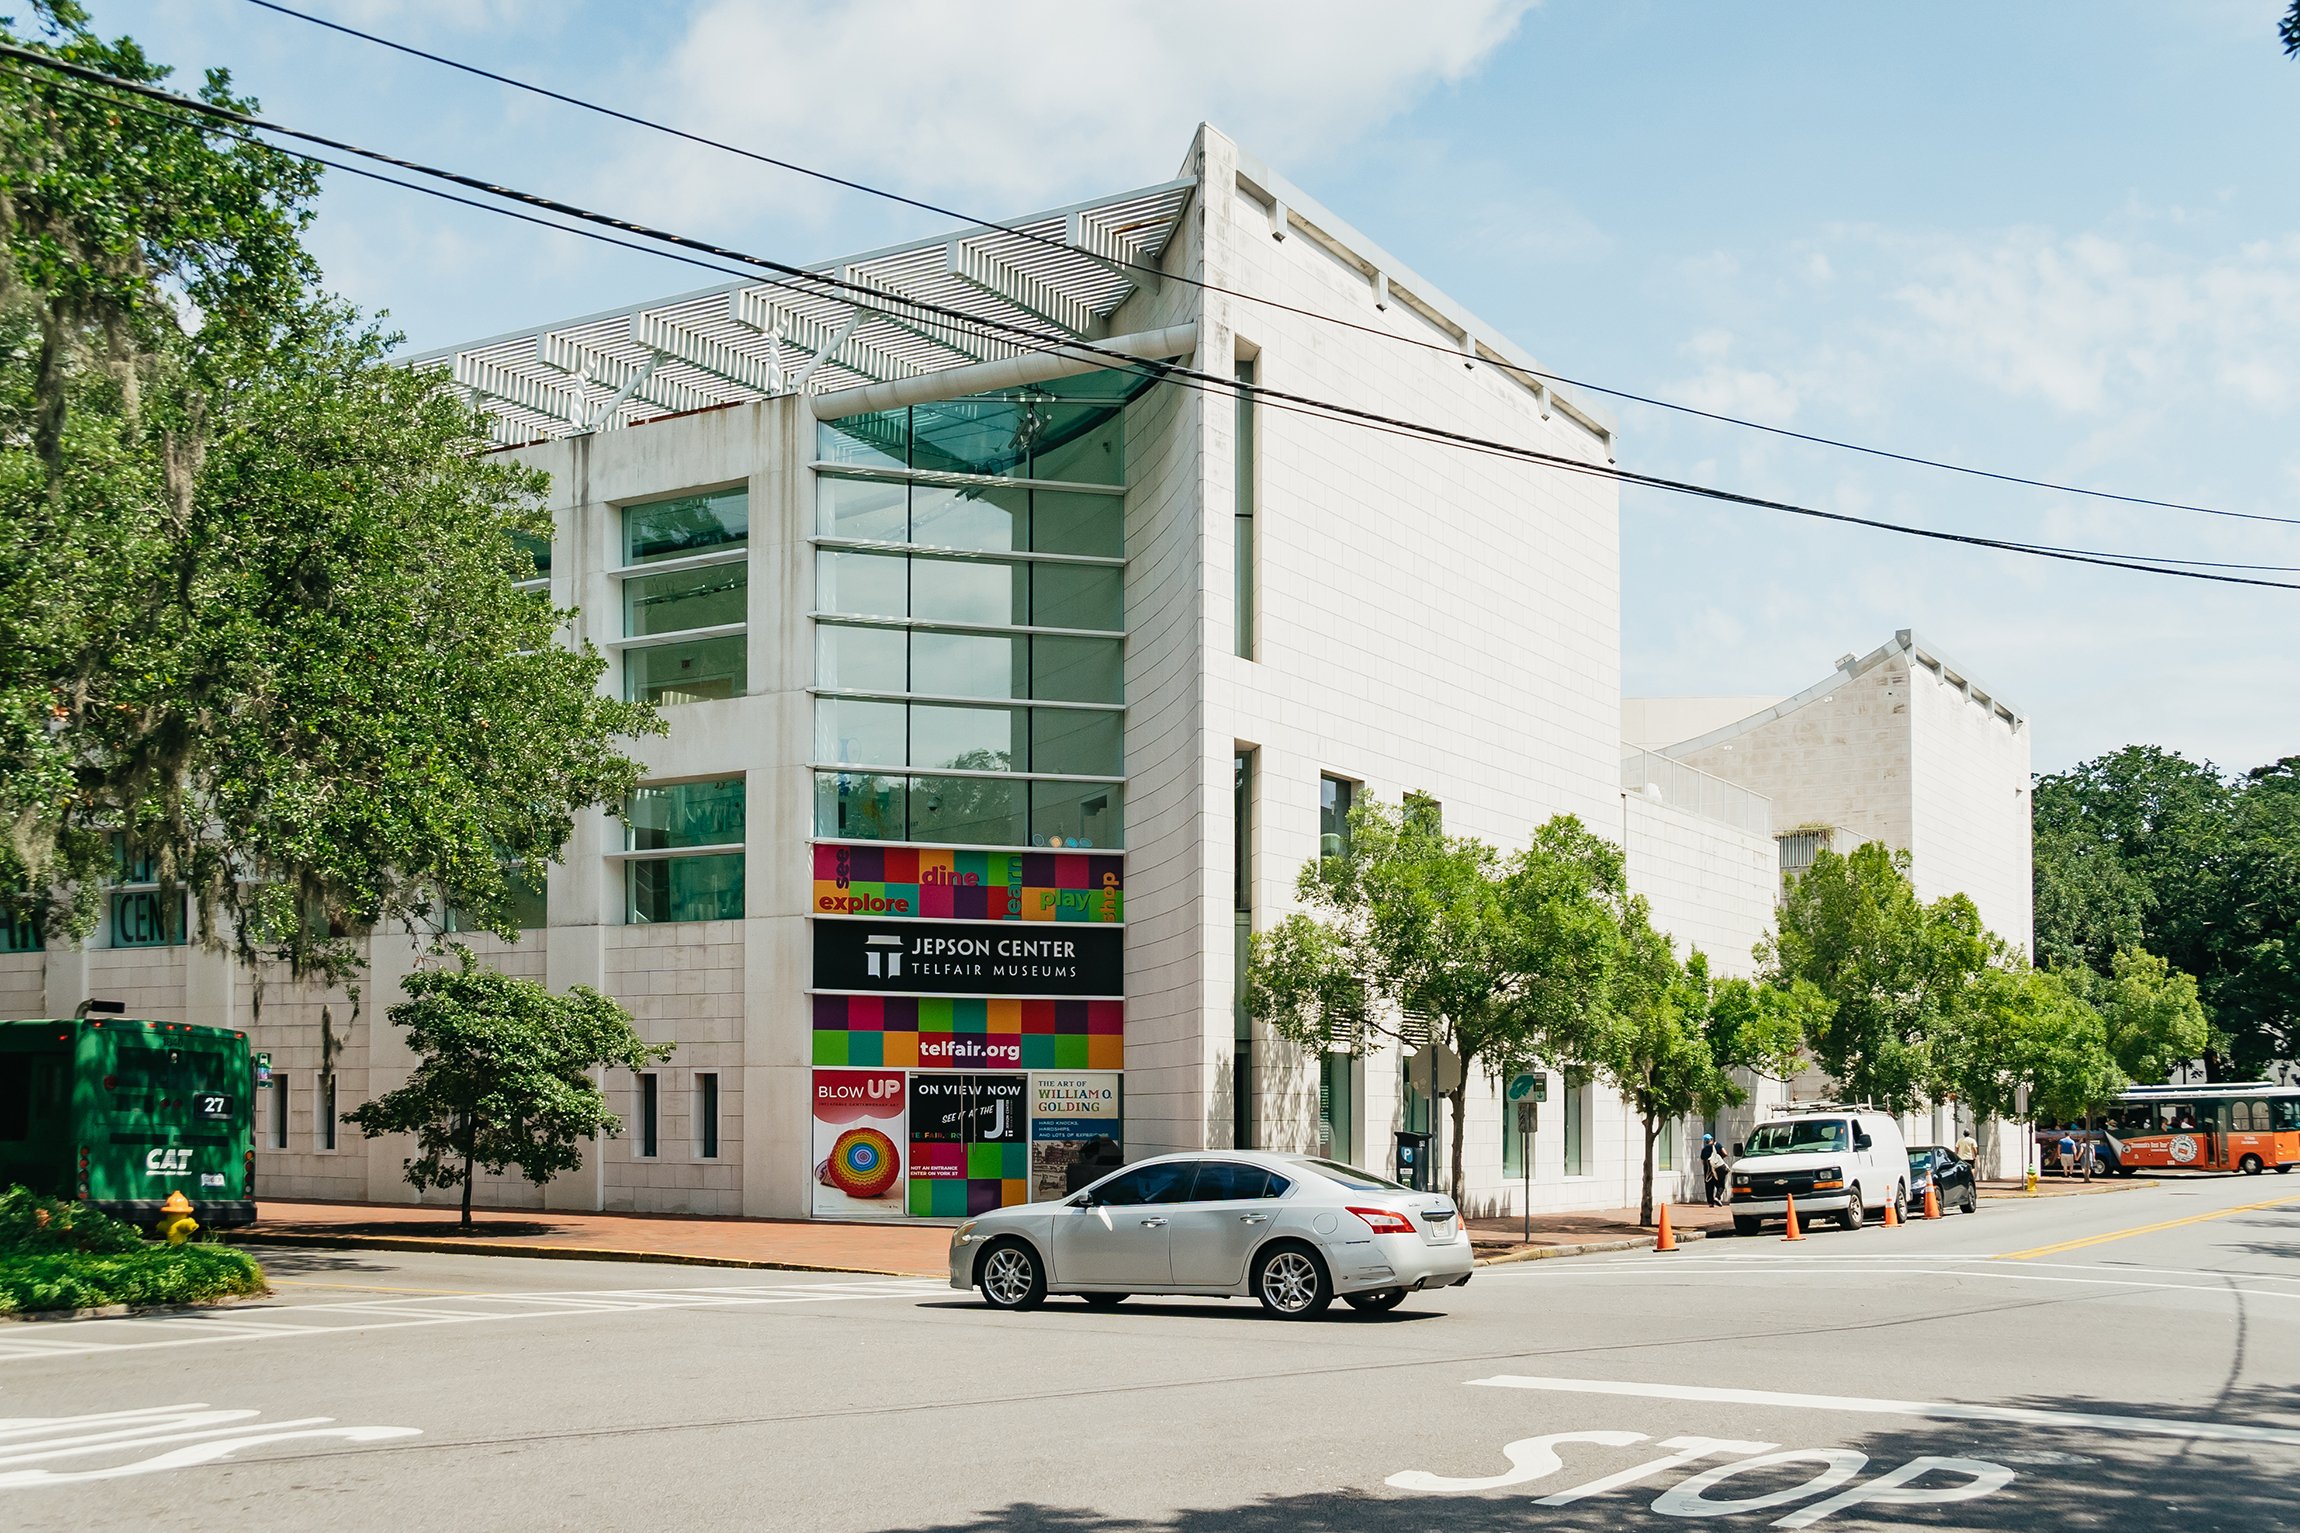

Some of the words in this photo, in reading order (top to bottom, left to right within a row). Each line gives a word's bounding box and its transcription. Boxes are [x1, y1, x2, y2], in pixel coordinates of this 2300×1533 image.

[836, 849, 850, 889] see
[922, 865, 979, 887] dine
[1002, 856, 1022, 920] learn
[1100, 872, 1120, 923] shop
[819, 893, 909, 914] explore
[1041, 888, 1091, 911] play
[912, 938, 990, 956] JEPSON
[997, 940, 1076, 958] CENTER
[912, 963, 982, 976] TELFAIR
[993, 965, 1076, 978] MUSEUMS
[920, 1040, 1020, 1061] telfair.org
[818, 1086, 865, 1098] BLOW
[867, 1079, 901, 1099] UP
[918, 1085, 939, 1095] ON
[943, 1085, 982, 1095] VIEW
[987, 1085, 1021, 1096] NOW
[1038, 1089, 1100, 1099] WILLIAM
[1101, 1089, 1113, 1099] O.
[204, 1097, 225, 1112] 27
[980, 1104, 995, 1116] THE
[1038, 1102, 1100, 1112] GOLDING
[942, 1112, 957, 1124] SEE
[984, 1098, 1005, 1139] J
[146, 1148, 194, 1170] CAT
[1404, 1148, 1412, 1161] P
[1383, 1429, 2017, 1530] STOP
